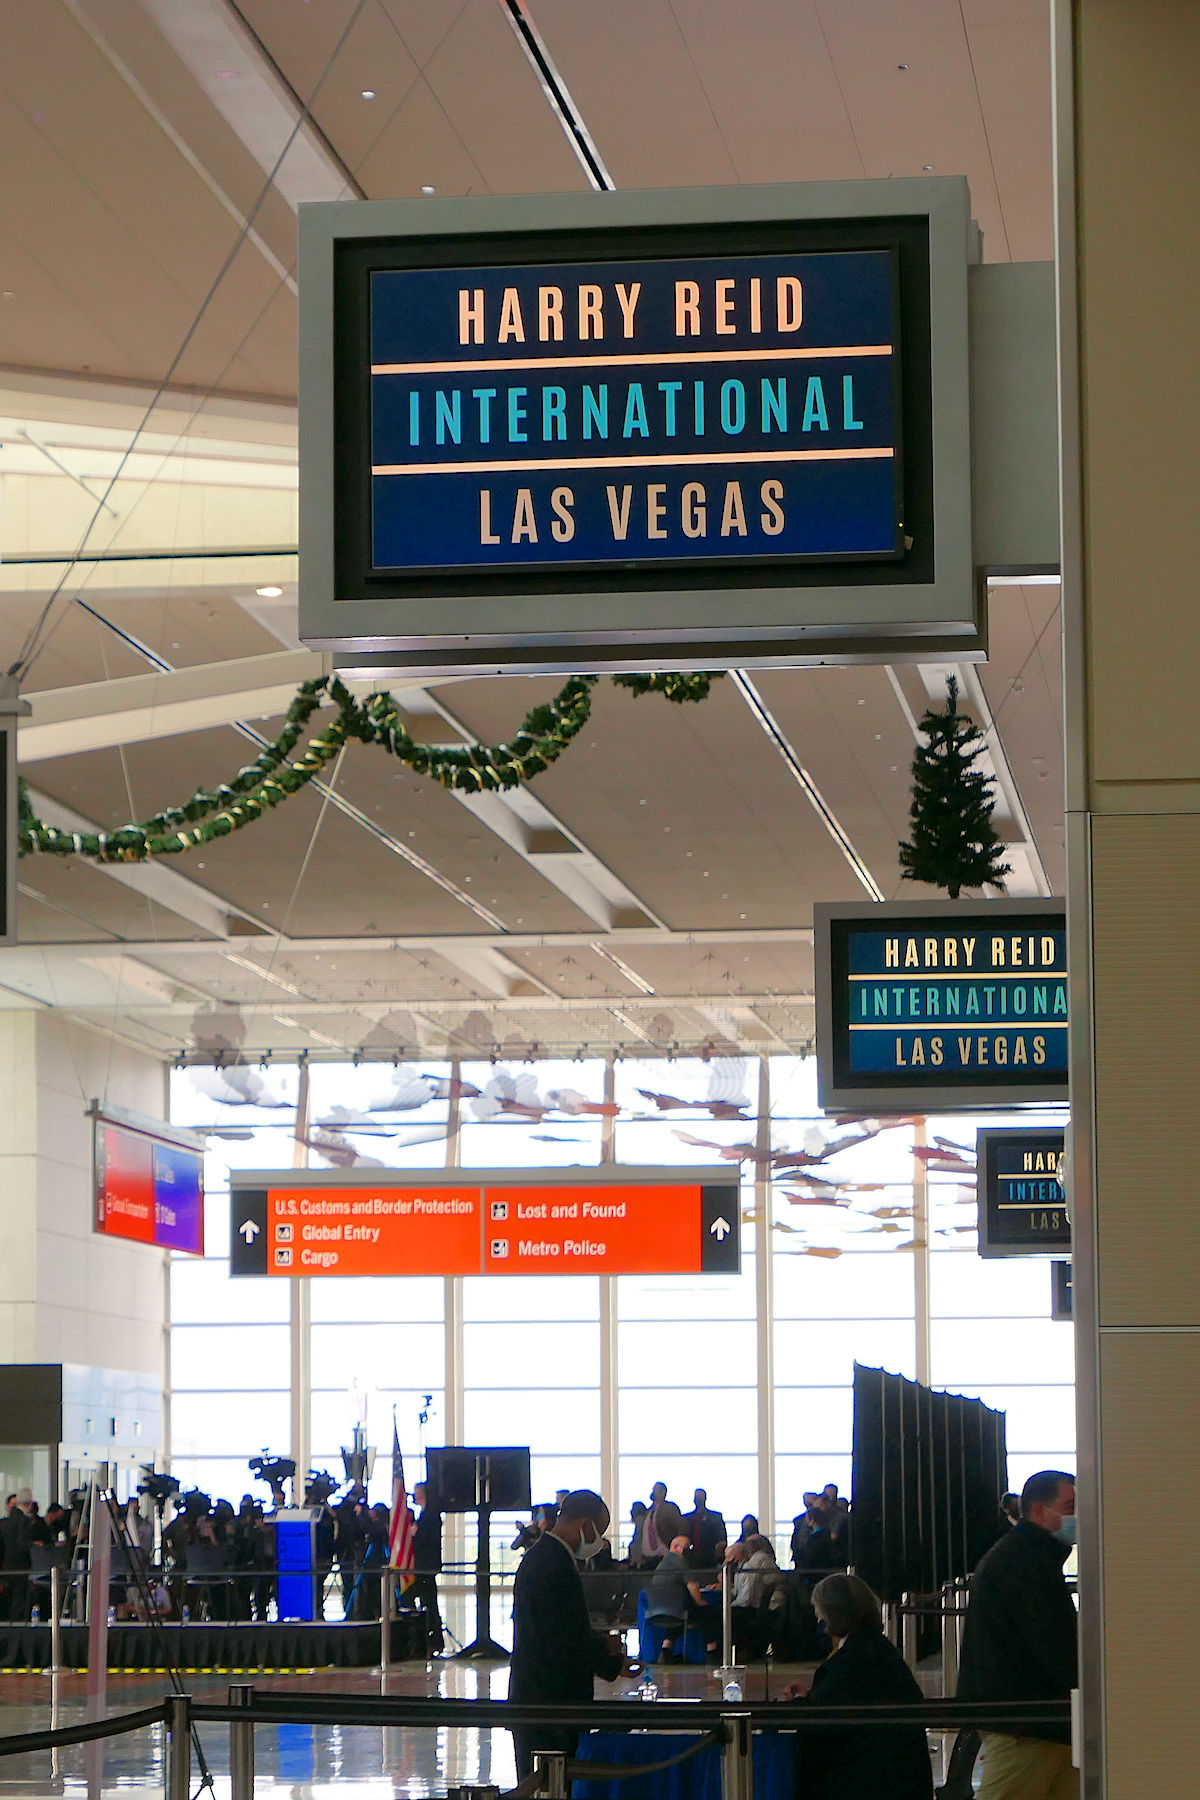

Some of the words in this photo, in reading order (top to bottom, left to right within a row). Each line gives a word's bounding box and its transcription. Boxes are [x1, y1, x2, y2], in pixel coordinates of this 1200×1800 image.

[457, 282, 643, 345] HARRY
[674, 276, 805, 337] REID
[408, 373, 865, 447] INTERNATIONAL
[480, 486, 576, 546] LAS
[606, 478, 787, 540] VEGAS
[884, 937, 977, 968] HARRY
[990, 936, 1056, 967] REID
[896, 1037, 945, 1066] LAS
[958, 1035, 1047, 1066] VEGAS
[274, 1199, 298, 1215] U.S.
[299, 1199, 350, 1215] Customs
[351, 1199, 374, 1215] and
[374, 1199, 413, 1215] Border
[413, 1198, 474, 1215] Protection
[517, 1203, 547, 1219] Lost
[550, 1202, 578, 1219] and
[582, 1202, 627, 1218] Found
[1030, 1212, 1060, 1230] LAS
[301, 1224, 341, 1241] Global
[344, 1224, 380, 1243] Entry
[300, 1248, 339, 1268] Cargo
[518, 1240, 560, 1257] Metro
[563, 1239, 607, 1256] Police
